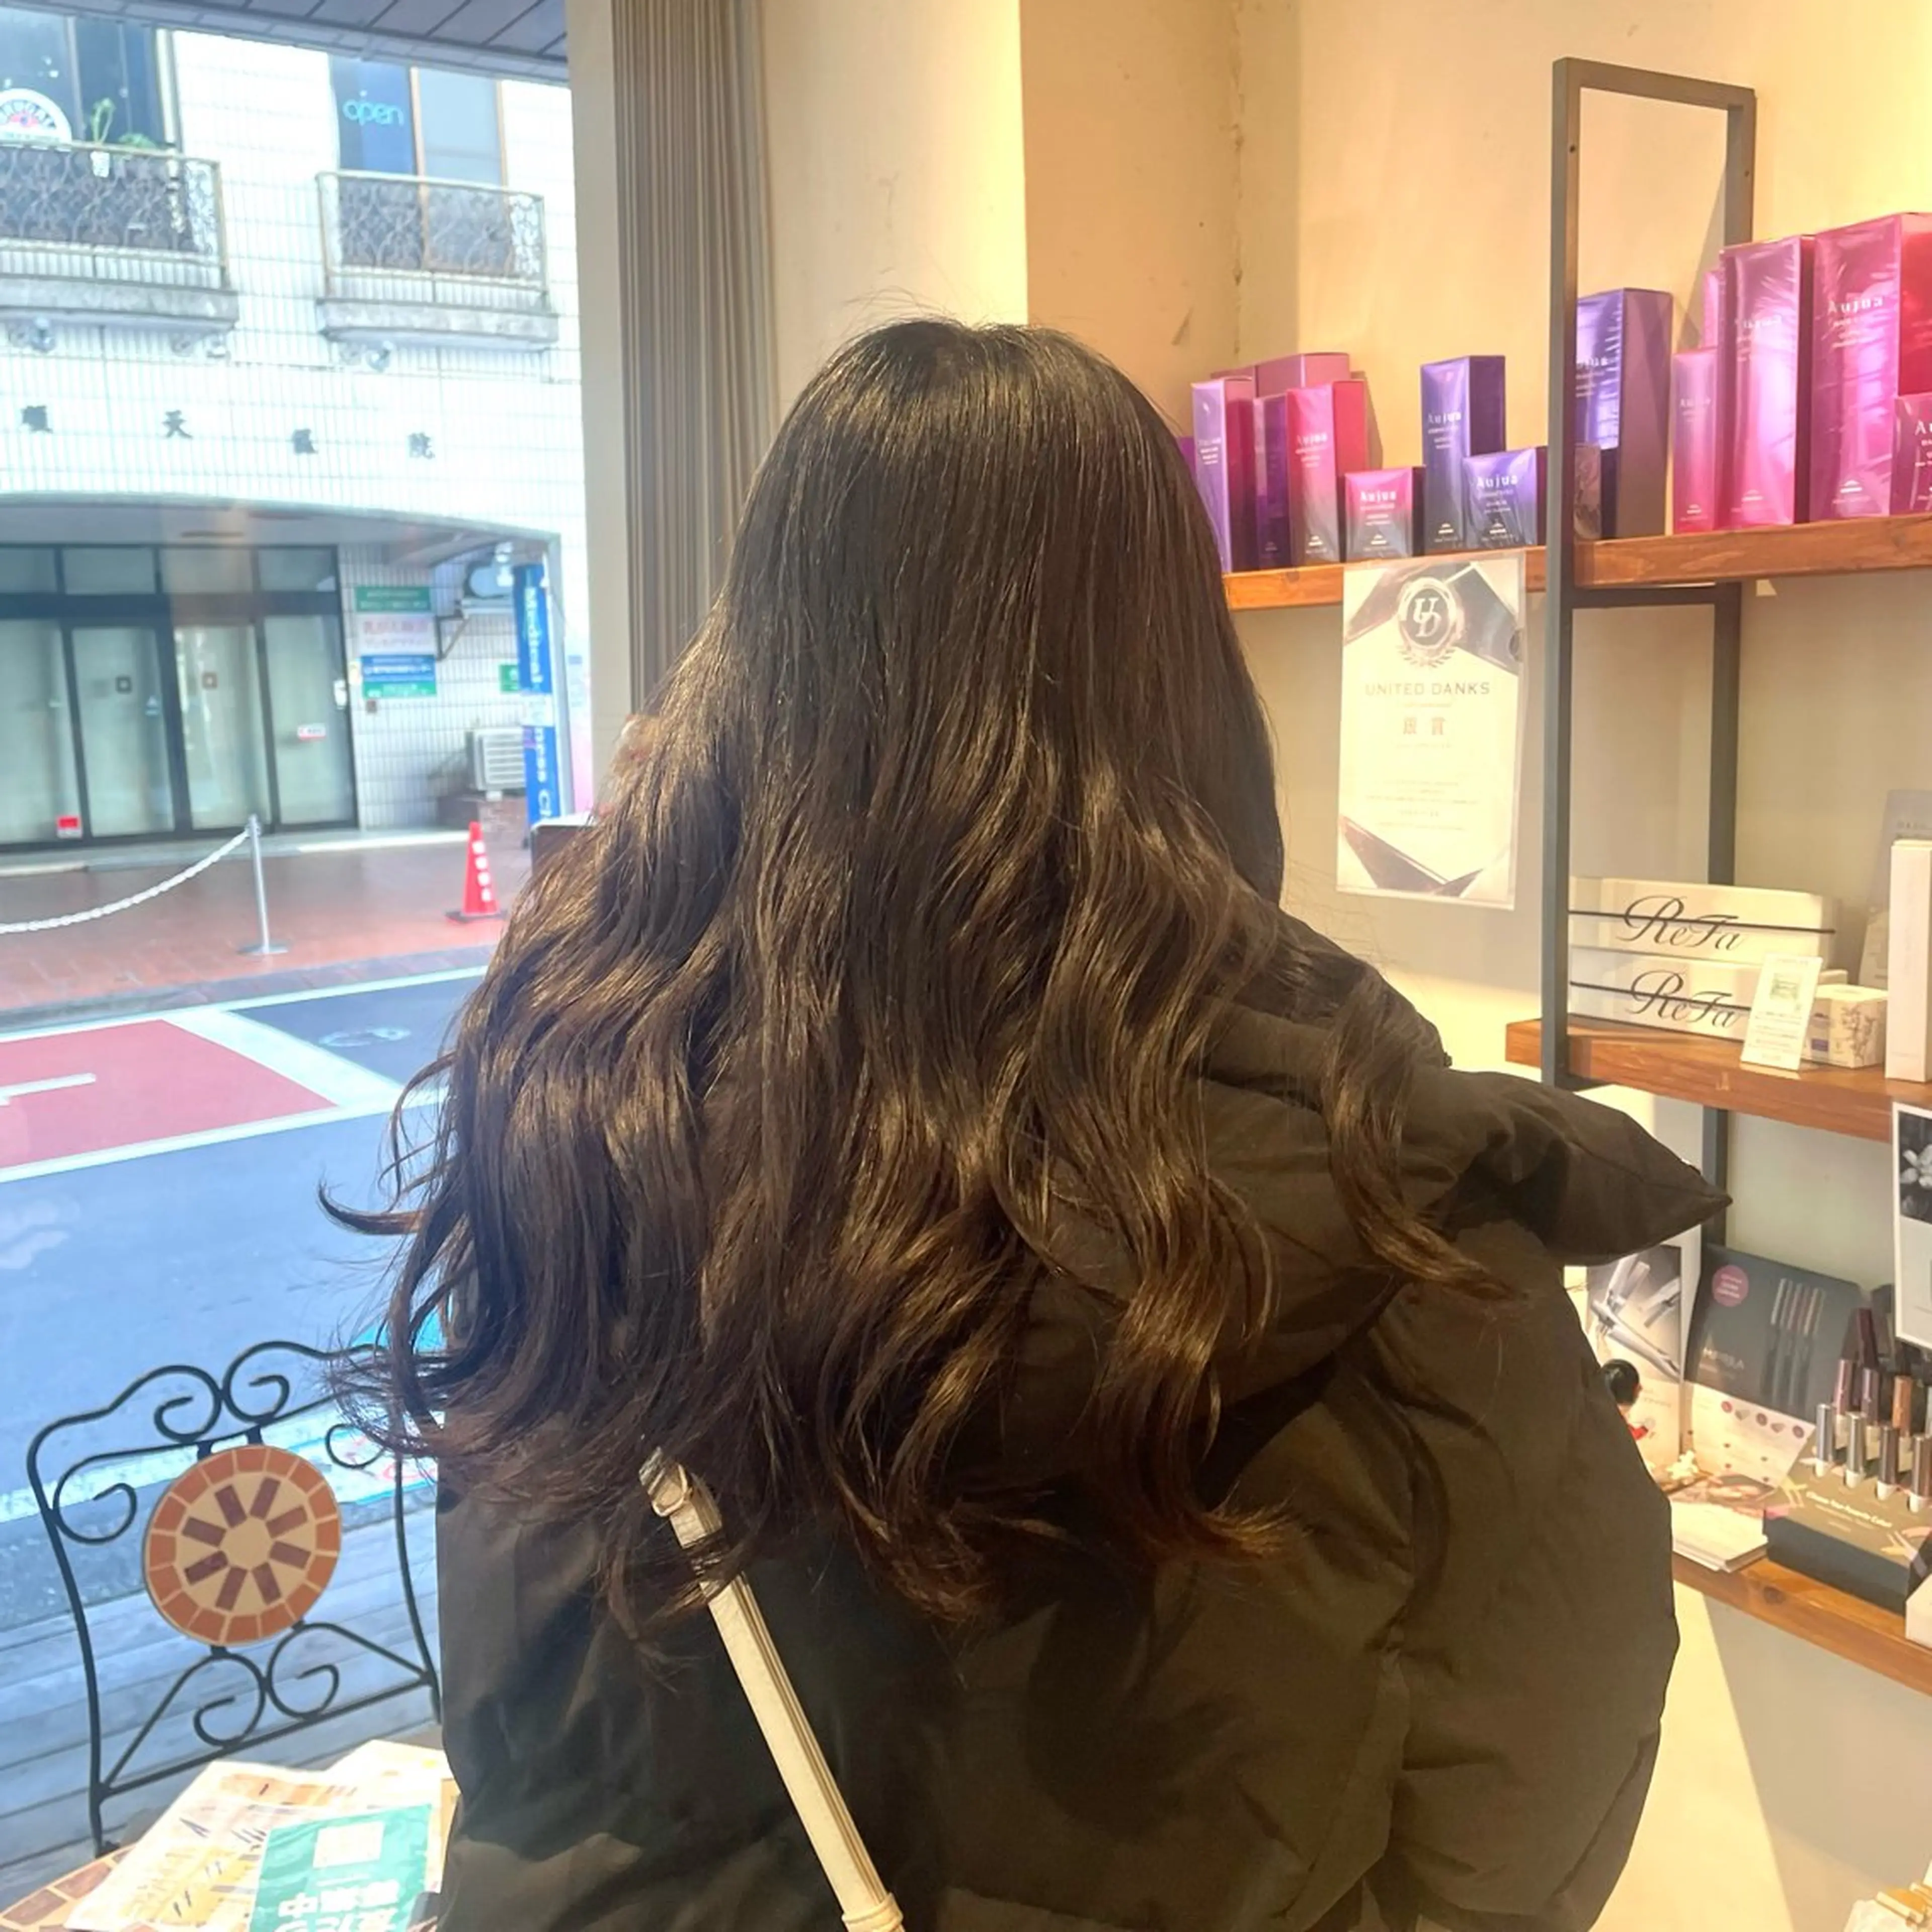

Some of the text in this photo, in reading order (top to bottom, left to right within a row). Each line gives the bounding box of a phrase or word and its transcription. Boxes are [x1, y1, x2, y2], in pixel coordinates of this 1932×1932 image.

[343, 100, 404, 126] open
[1364, 681, 1491, 696] UNITED DANKS
[1616, 895, 1747, 952] ReFa
[1625, 969, 1743, 1029] ReFa
